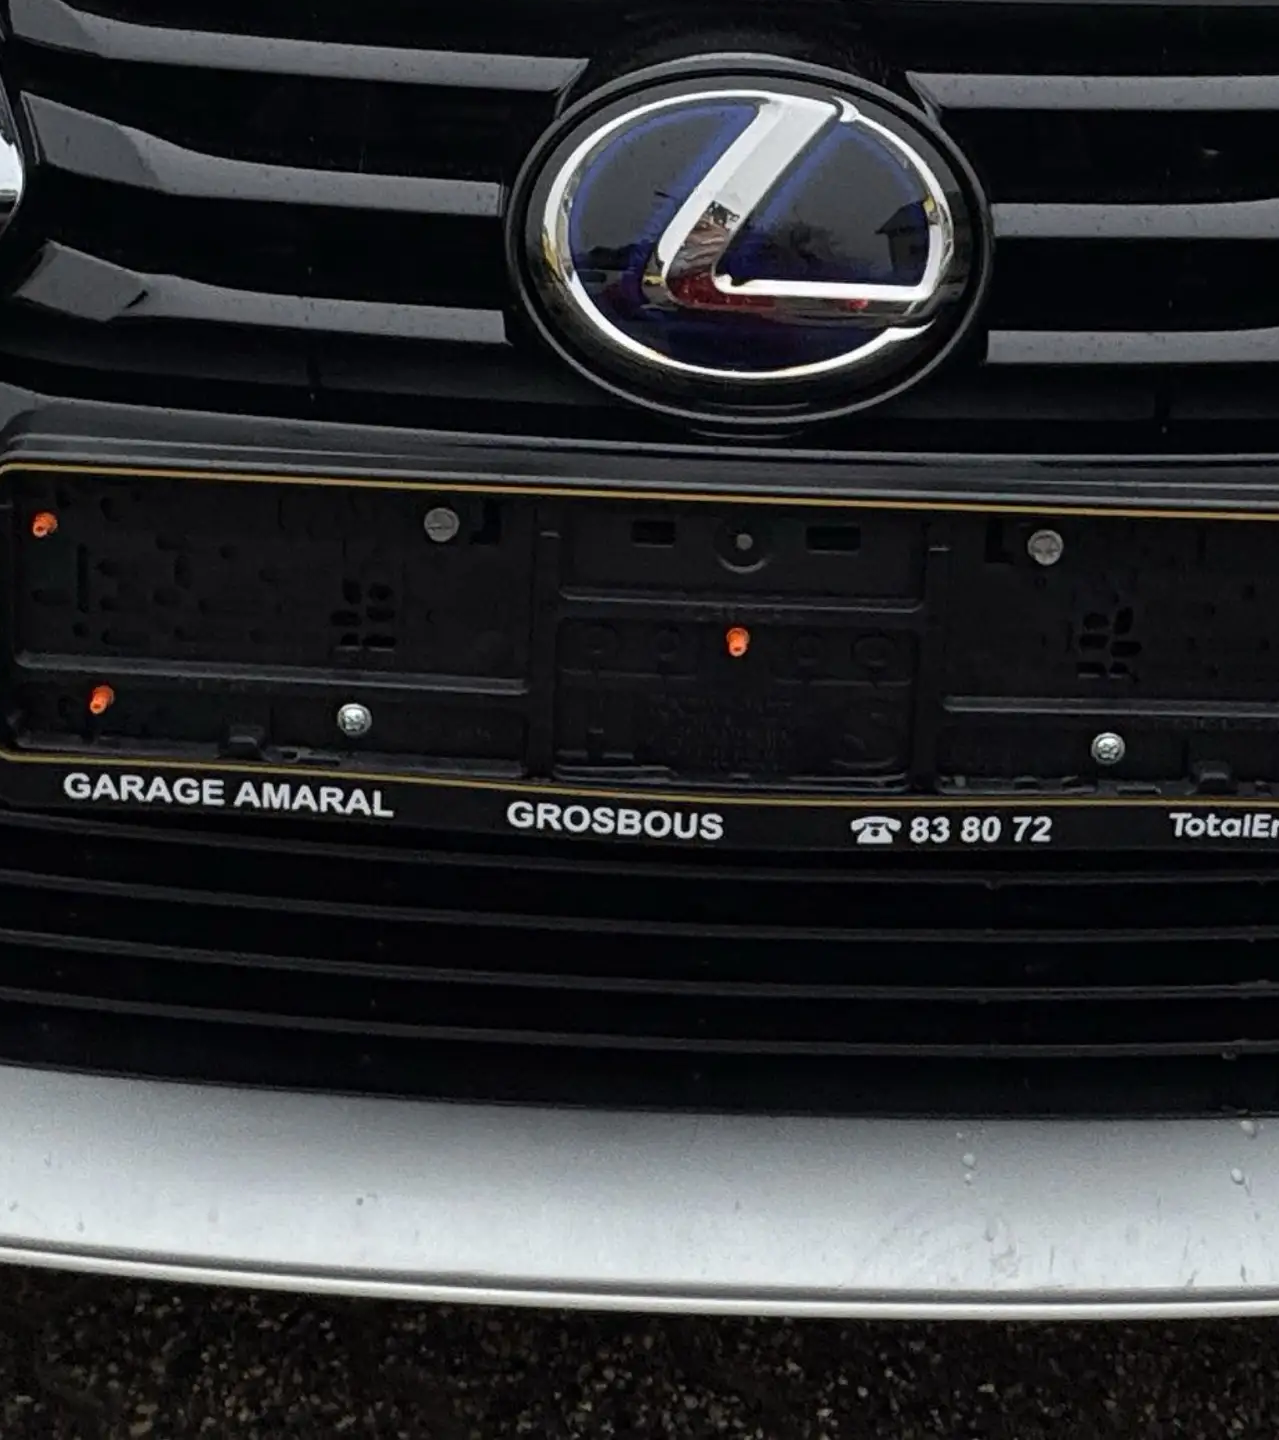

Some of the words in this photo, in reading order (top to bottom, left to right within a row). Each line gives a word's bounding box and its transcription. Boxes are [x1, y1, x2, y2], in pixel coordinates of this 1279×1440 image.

[63, 772, 225, 806] GARAGE
[234, 781, 395, 818] AMARAL
[506, 800, 725, 841] GROSBOUS
[909, 816, 951, 844] 83
[960, 816, 1002, 843] 80
[1012, 816, 1053, 843] 72
